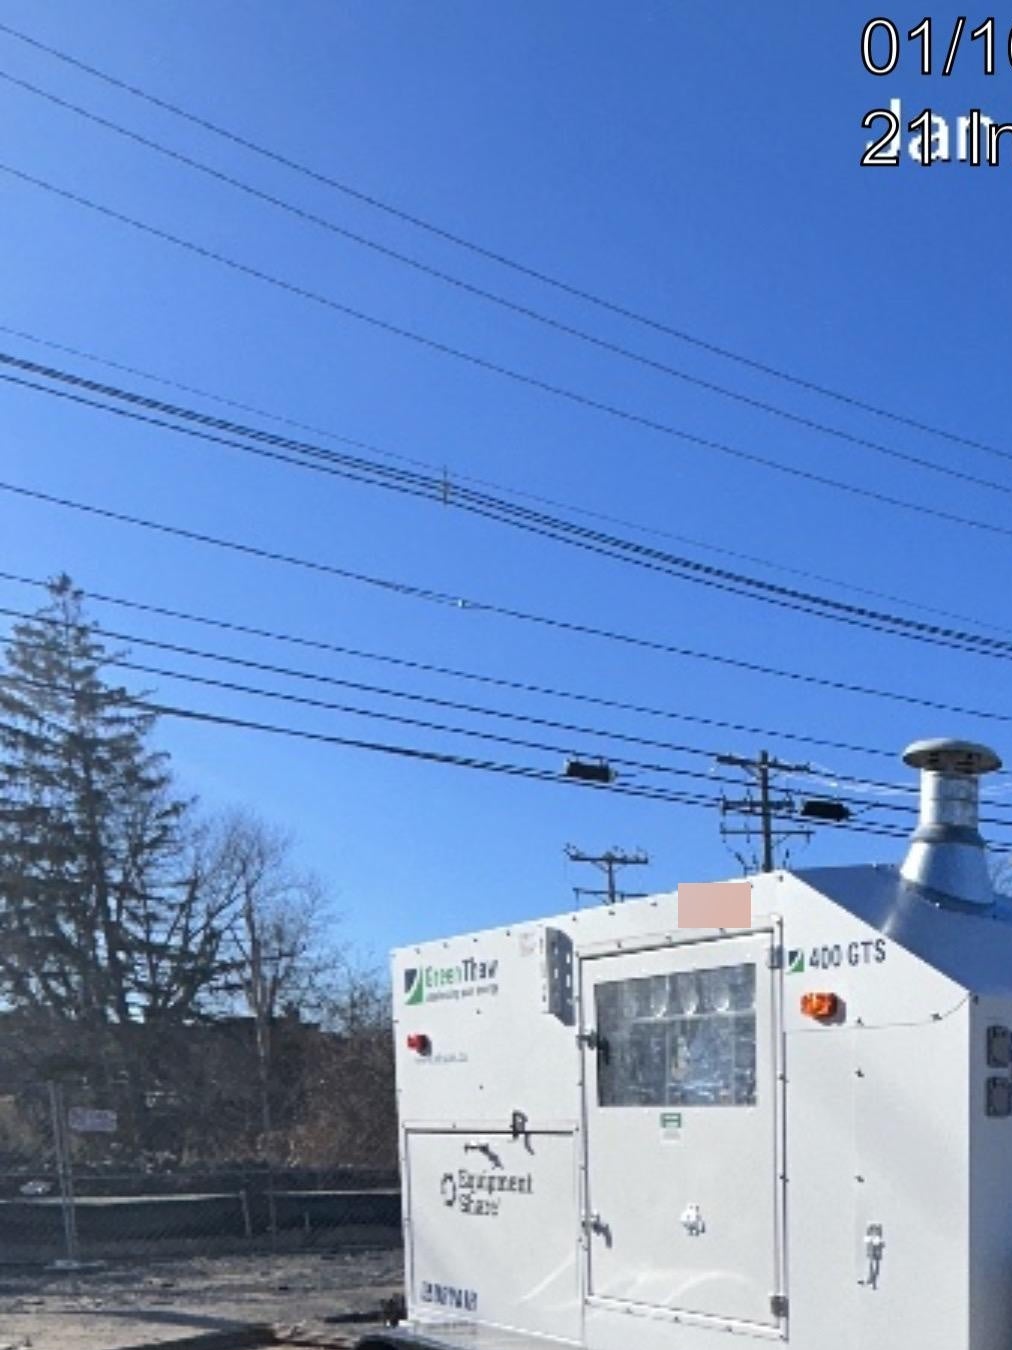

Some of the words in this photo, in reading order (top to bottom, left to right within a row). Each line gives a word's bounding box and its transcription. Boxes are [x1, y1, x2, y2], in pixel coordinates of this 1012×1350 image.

[809, 944, 842, 970] 400
[847, 938, 886, 967] GTS
[458, 1169, 534, 1195] Equipment
